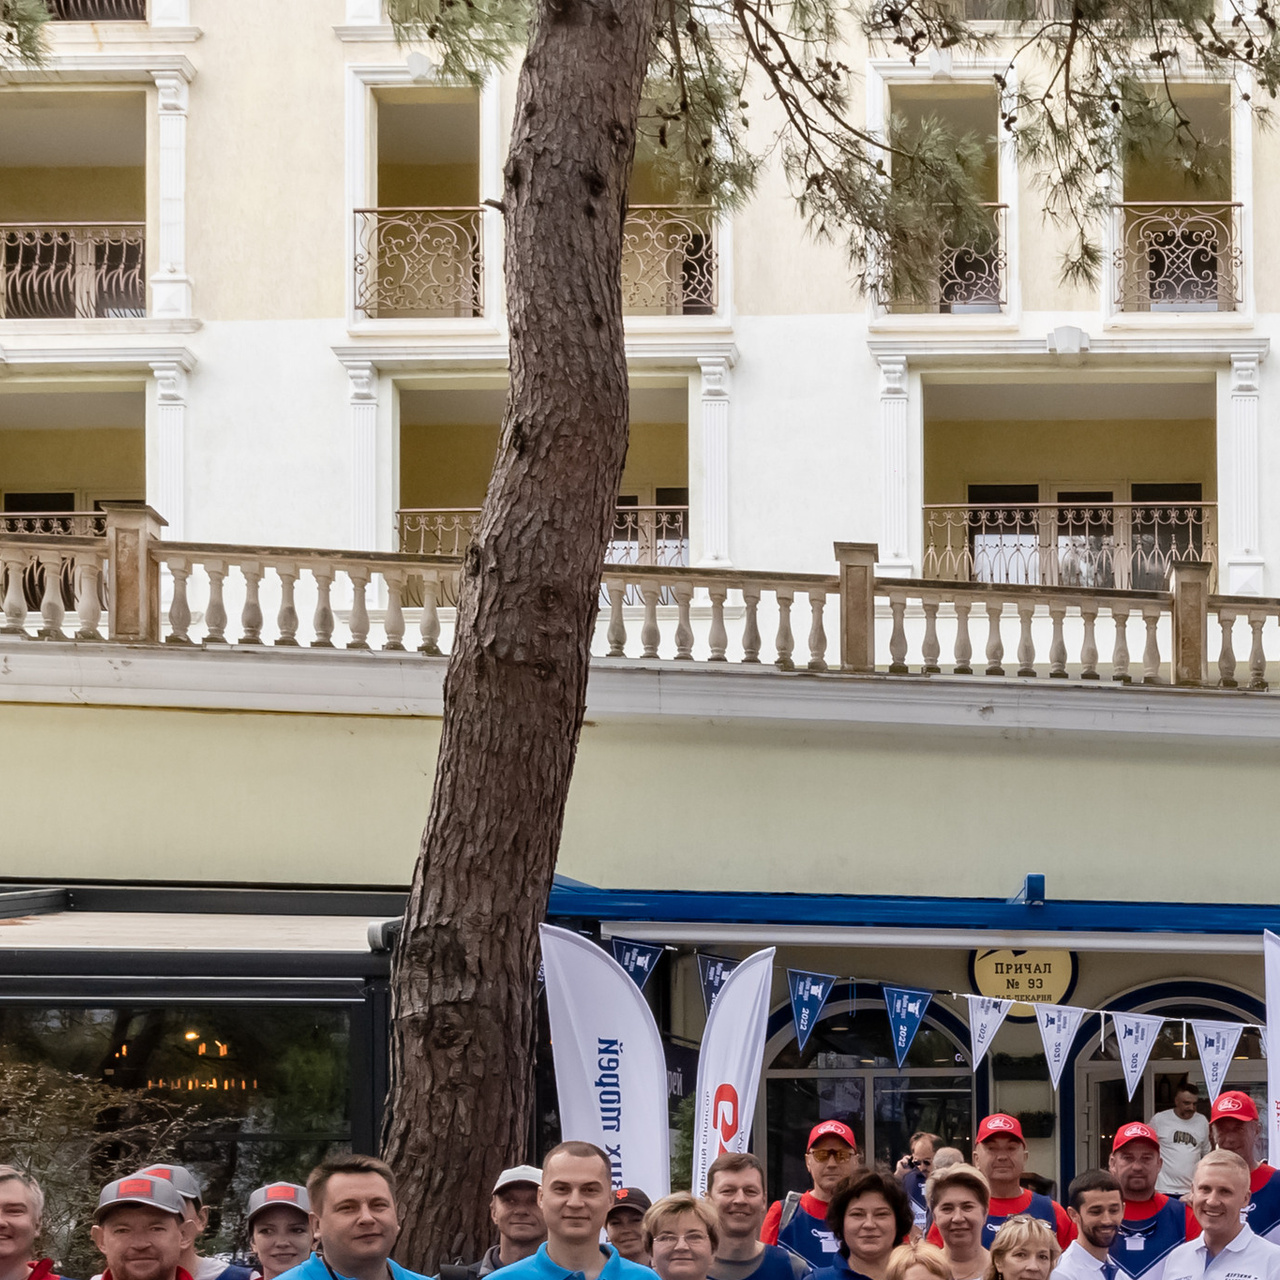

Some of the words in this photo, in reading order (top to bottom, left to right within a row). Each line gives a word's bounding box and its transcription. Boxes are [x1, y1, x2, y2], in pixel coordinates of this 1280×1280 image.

[995, 963, 1052, 975] ПРИЧАЛ
[1006, 979, 1020, 989] №
[1028, 979, 1043, 989] 93
[800, 1008, 810, 1031] 2022
[898, 1025, 908, 1047] 2022
[977, 1023, 988, 1044] 2021
